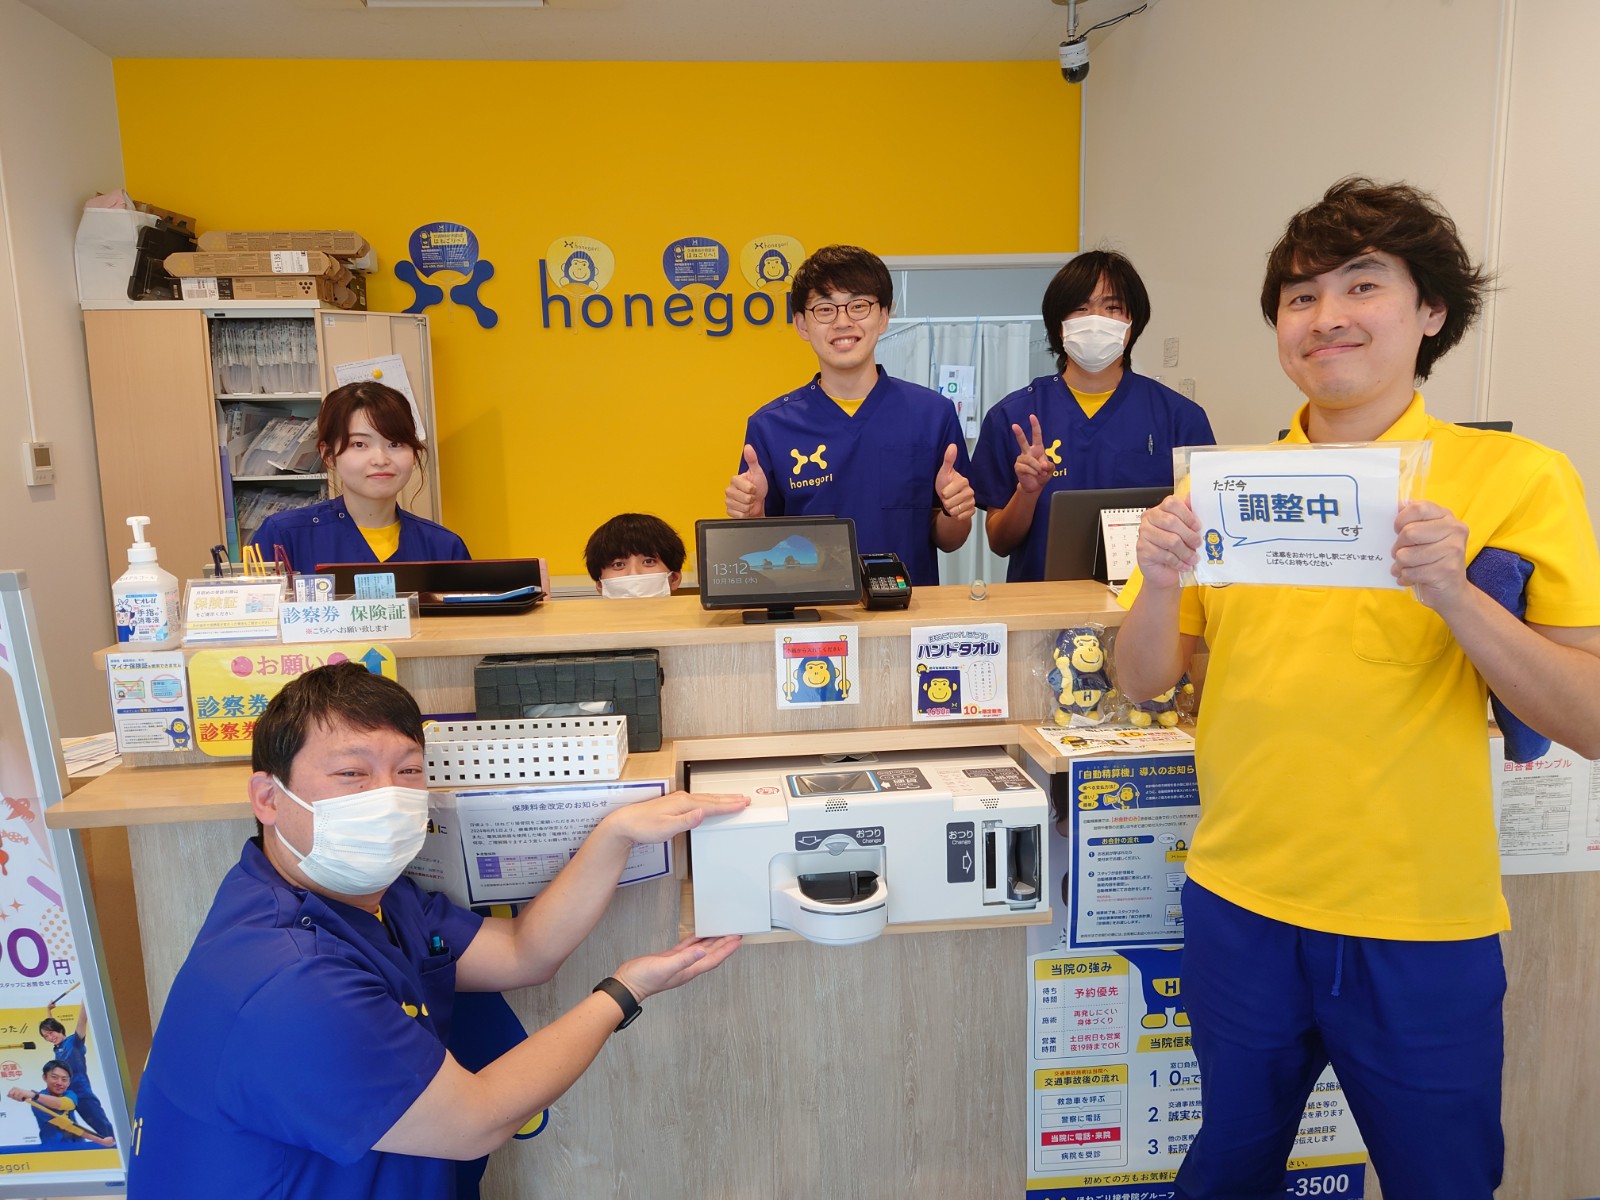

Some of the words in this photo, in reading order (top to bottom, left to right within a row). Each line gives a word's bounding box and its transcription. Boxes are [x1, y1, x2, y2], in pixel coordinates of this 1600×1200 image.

[790, 474, 833, 489] honegori
[1213, 480, 1247, 491] ただ今
[1238, 493, 1340, 524] 調整中
[1337, 525, 1363, 537] です
[1265, 551, 1383, 561] ご迷惑をおかけし申し訳ございません
[1266, 559, 1333, 567] しばらくお待ちください
[712, 563, 748, 576] 13:12
[193, 596, 239, 609] 保険証
[137, 609, 159, 617] 手指の
[282, 605, 340, 624] 診察券
[350, 603, 407, 622] 保険証
[138, 617, 160, 625] 消毒液
[917, 641, 1001, 659] ハンドタオル
[256, 654, 325, 676] お願い
[1084, 692, 1092, 701] H
[196, 693, 269, 718] 診察券
[1503, 759, 1573, 772] 回答書サンプル
[512, 801, 608, 812] 保険料金改定のお知らせ
[856, 829, 881, 838] おつり
[948, 830, 973, 839] おつり
[0, 928, 71, 978] 0円
[1051, 961, 1112, 976] 当院の強み
[1042, 987, 1057, 995] 待ち
[1074, 986, 1119, 999] 予約優先
[1165, 980, 1176, 994] H
[1074, 1008, 1118, 1017] 再発しにくい
[1042, 1016, 1057, 1024] 施術
[1077, 1017, 1114, 1026] 身体づくり
[1070, 1032, 1121, 1042] 土日祝日も営業
[1042, 1045, 1056, 1053] 時間
[1070, 1042, 1121, 1052] 夜19時までOK
[1044, 1074, 1119, 1086] 交通事故後の流れ
[1169, 1070, 1202, 1086] 0円で
[1057, 1095, 1106, 1105] 救急車を呼ぶ
[1304, 1100, 1338, 1109] 続き等の
[1061, 1113, 1101, 1123] 警察に電話
[1168, 1110, 1202, 1122] 誠実な
[1297, 1125, 1337, 1136] な通院目安
[1051, 1131, 1111, 1143] 当院に電話・来院
[1061, 1150, 1101, 1160] 病院を受診
[1083, 1171, 1177, 1185] 初めての方もお気軽に
[1287, 1174, 1346, 1197] -3500
